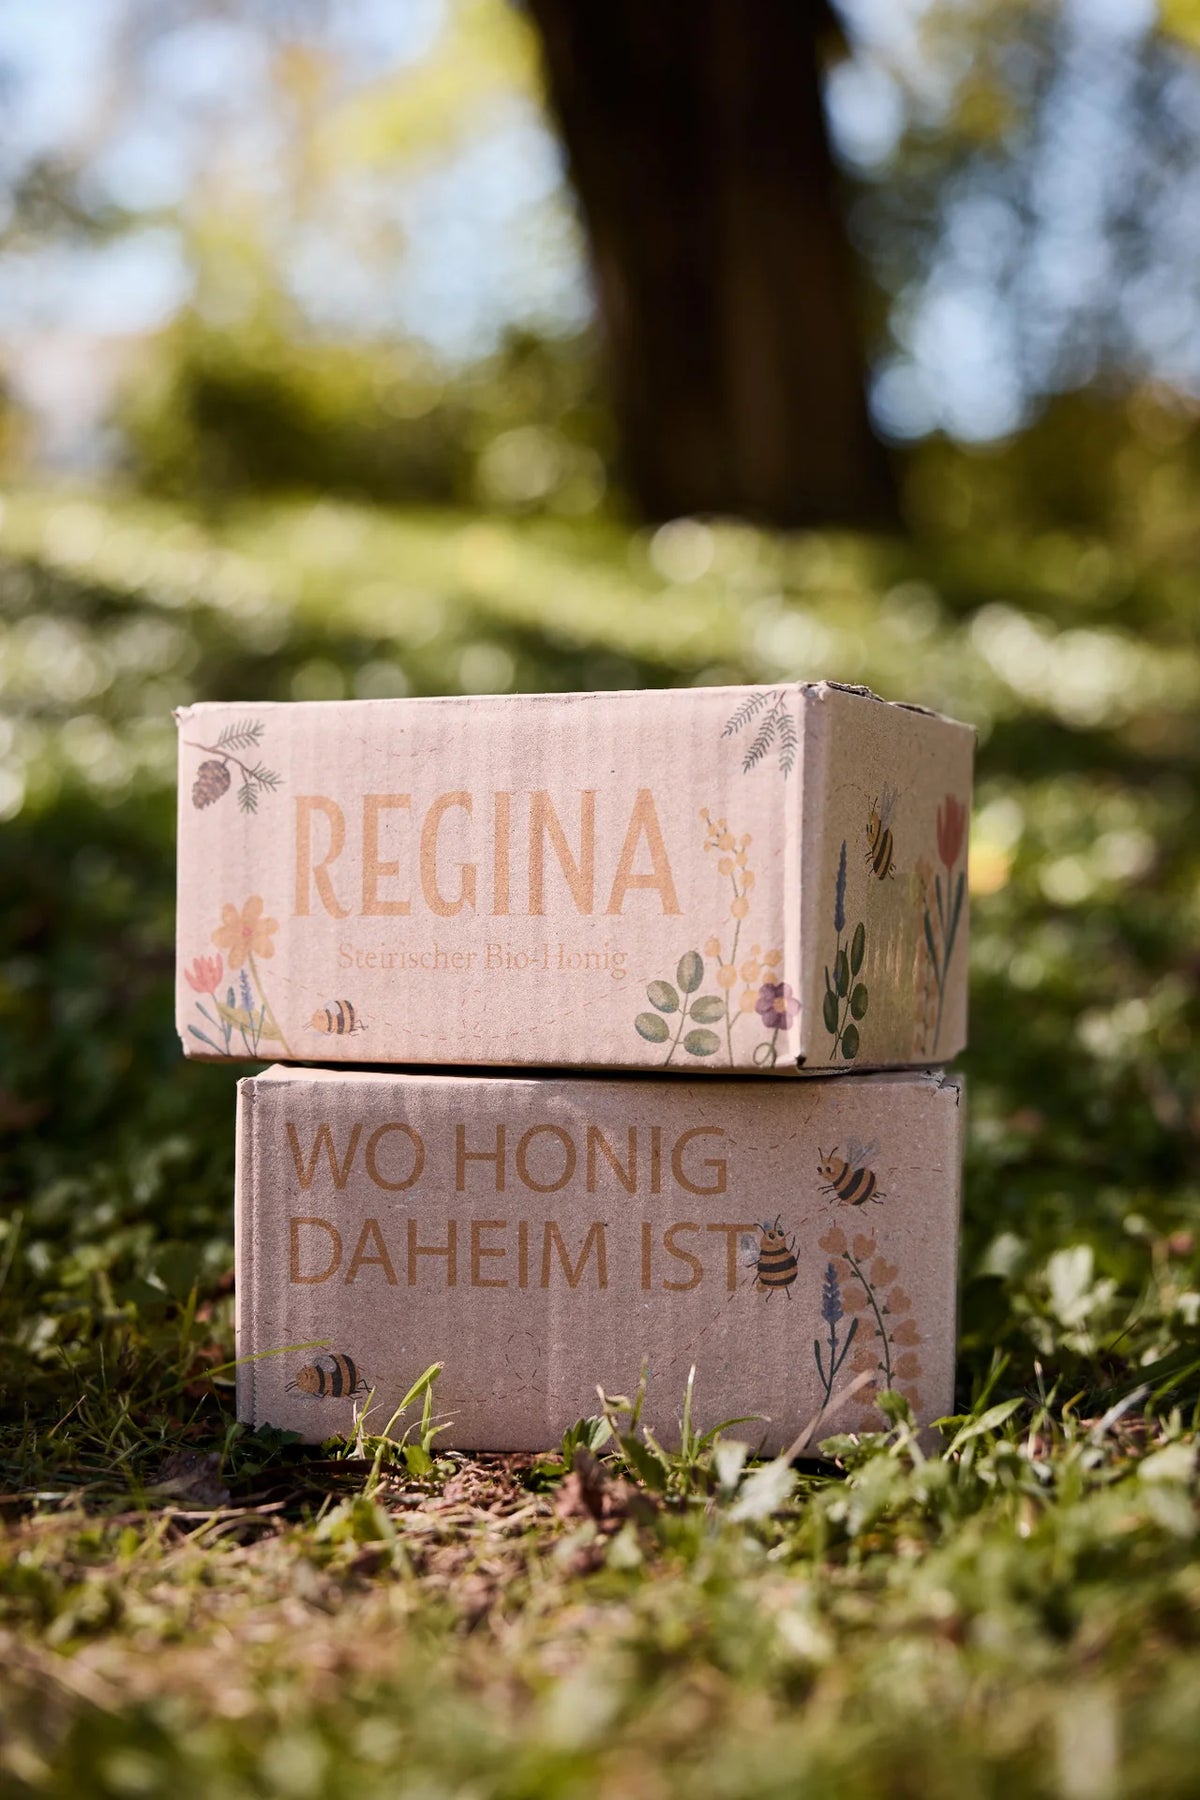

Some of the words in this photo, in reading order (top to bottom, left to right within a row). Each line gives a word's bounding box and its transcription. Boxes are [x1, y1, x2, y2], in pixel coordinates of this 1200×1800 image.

[293, 789, 684, 918] REGINA
[338, 941, 476, 970] Steirischer
[484, 942, 629, 980] Bio-Honig
[285, 1121, 425, 1192] WO
[456, 1123, 728, 1196] HONIG
[289, 1216, 608, 1289] DAHEIM
